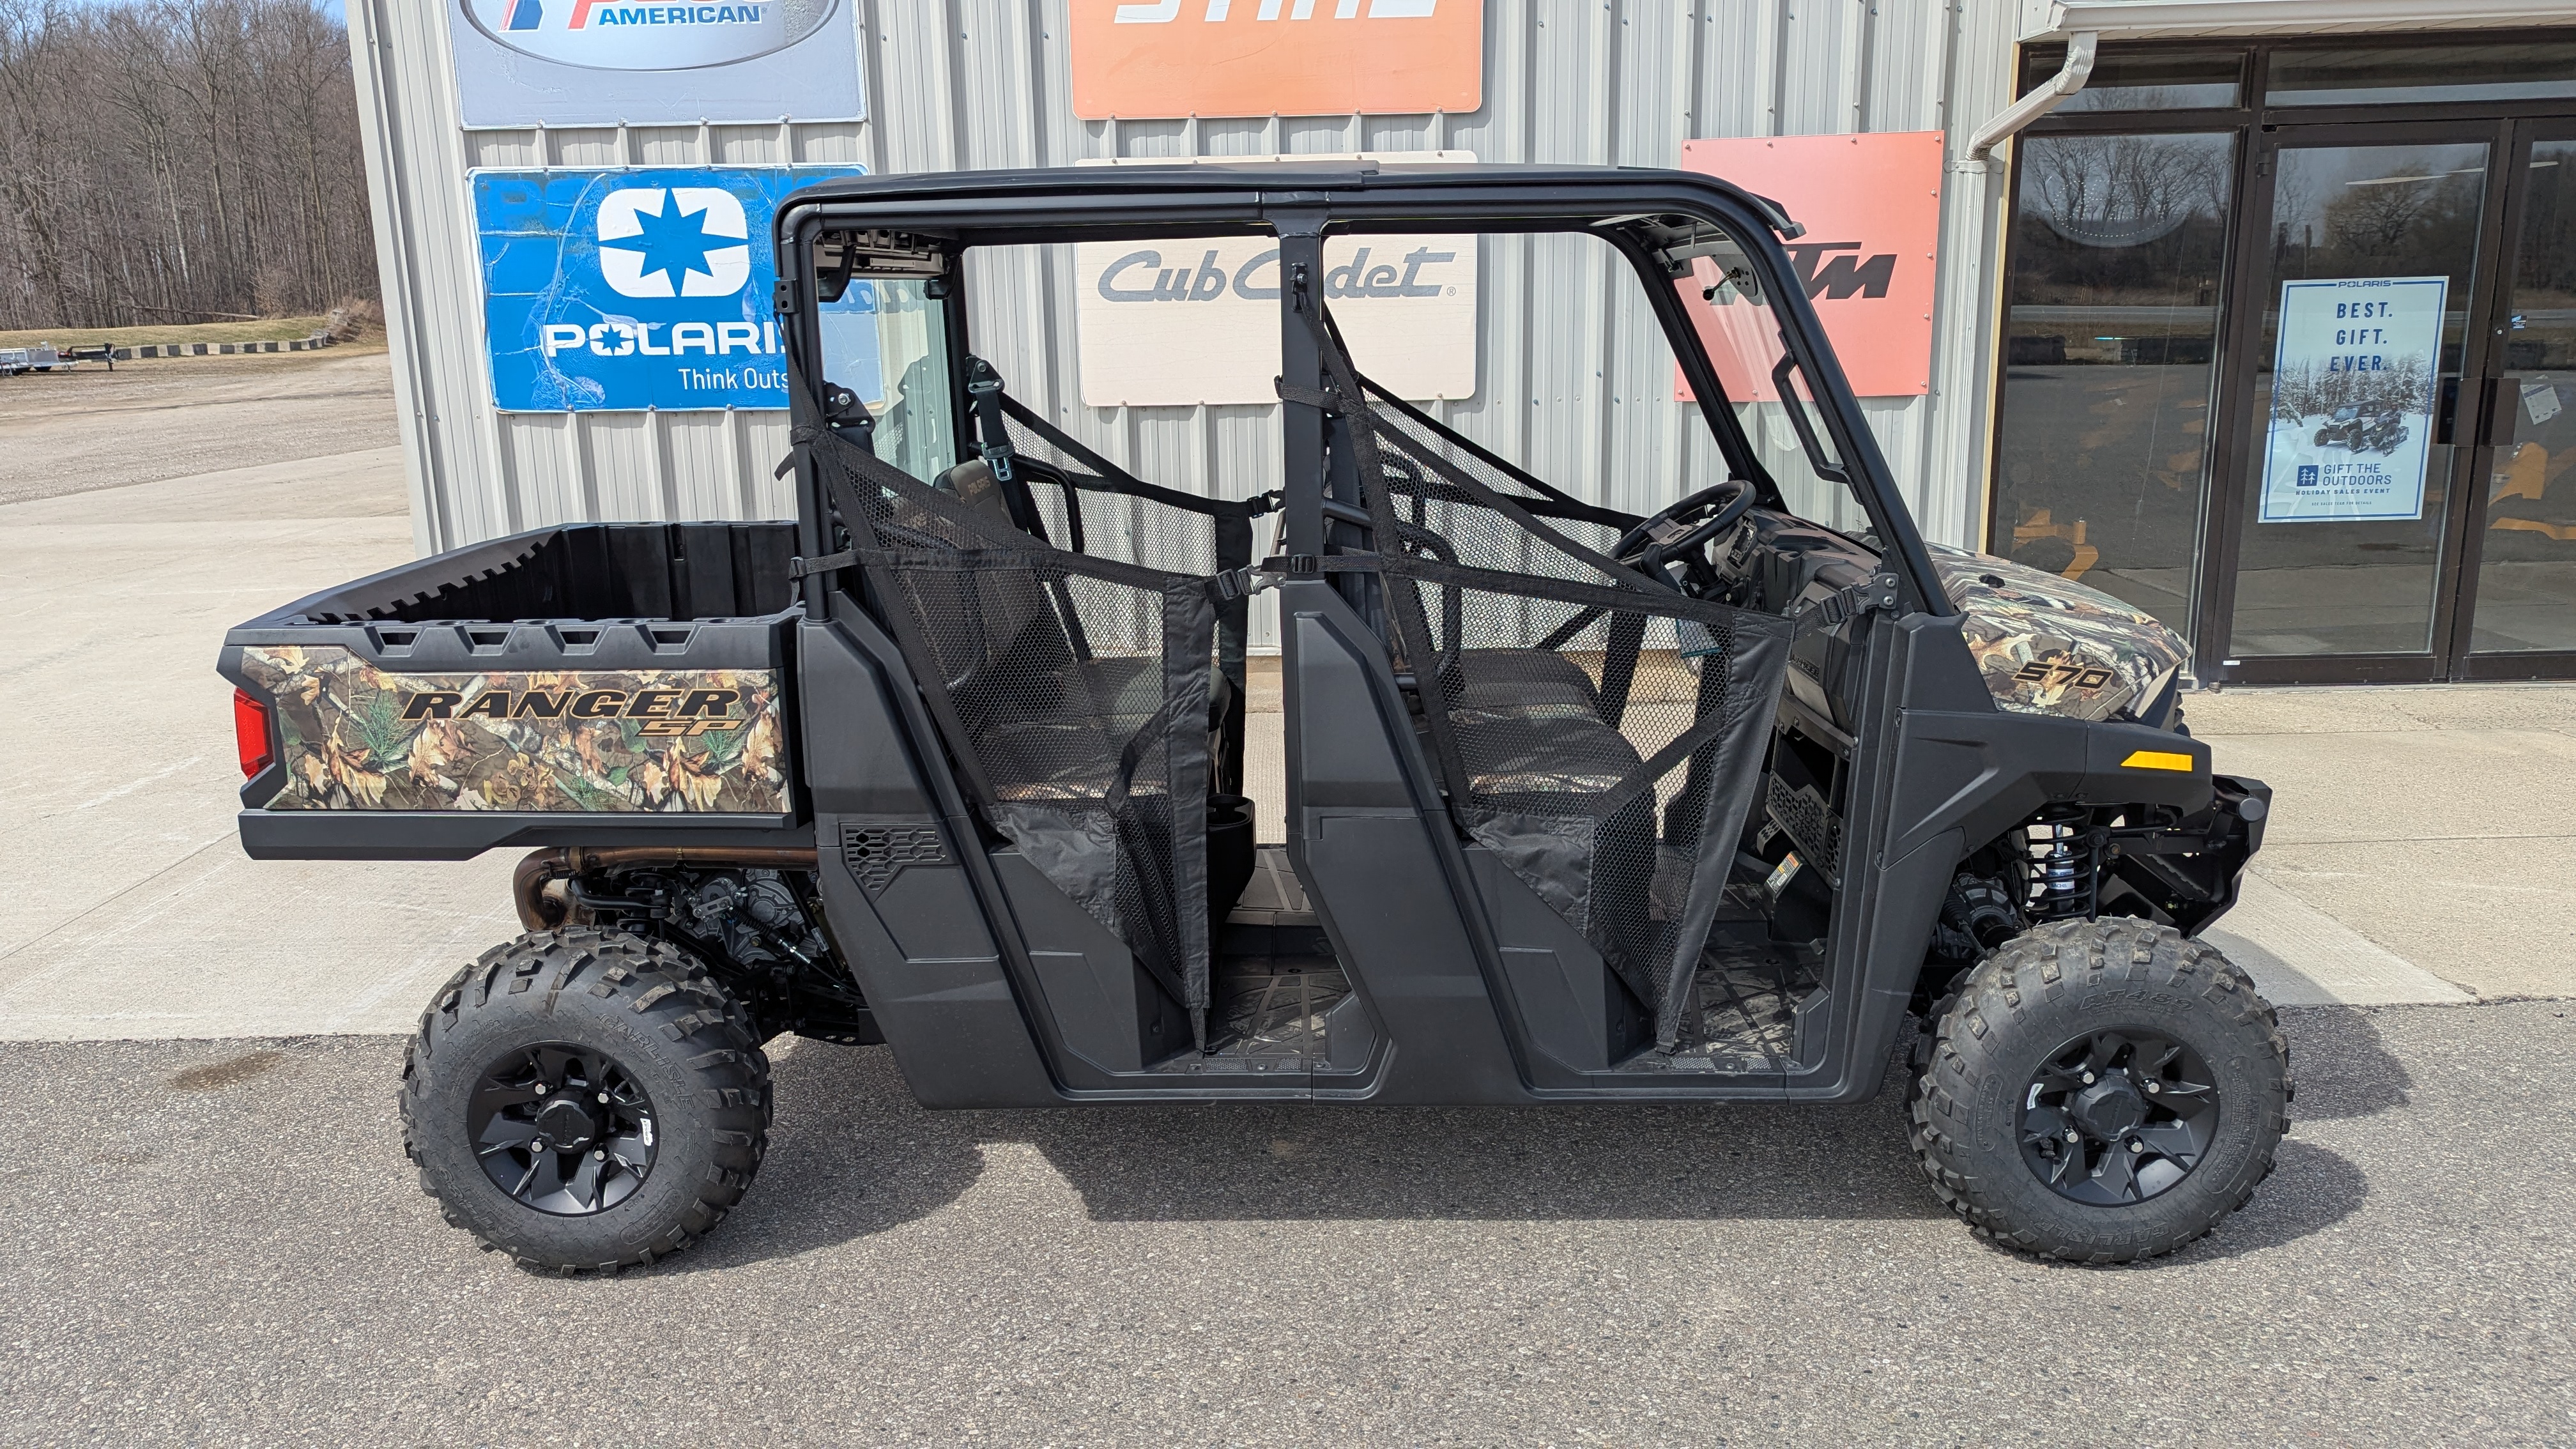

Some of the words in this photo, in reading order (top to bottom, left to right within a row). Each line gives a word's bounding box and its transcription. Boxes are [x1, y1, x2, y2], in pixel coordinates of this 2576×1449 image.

[598, 5, 760, 26] AMERICAN
[1098, 250, 1227, 302] Cub
[1232, 246, 1457, 301] Cdet
[2338, 280, 2392, 288] POLARIS
[2336, 302, 2393, 319] BEST.
[545, 321, 785, 357] POLARI
[2336, 328, 2388, 346] GIFT.
[2329, 355, 2388, 372] EVER.
[678, 368, 739, 390] Think
[2324, 463, 2354, 475] GIFT
[2356, 463, 2382, 473] THE
[2322, 474, 2393, 486] OUTDOORS
[2012, 660, 2115, 690] 570
[399, 688, 742, 721] RANGER
[635, 719, 745, 737] SP
[2079, 988, 2195, 1011] AT489
[599, 1013, 696, 1109] CARLISLE
[2034, 1217, 2170, 1247] CARLISLE
